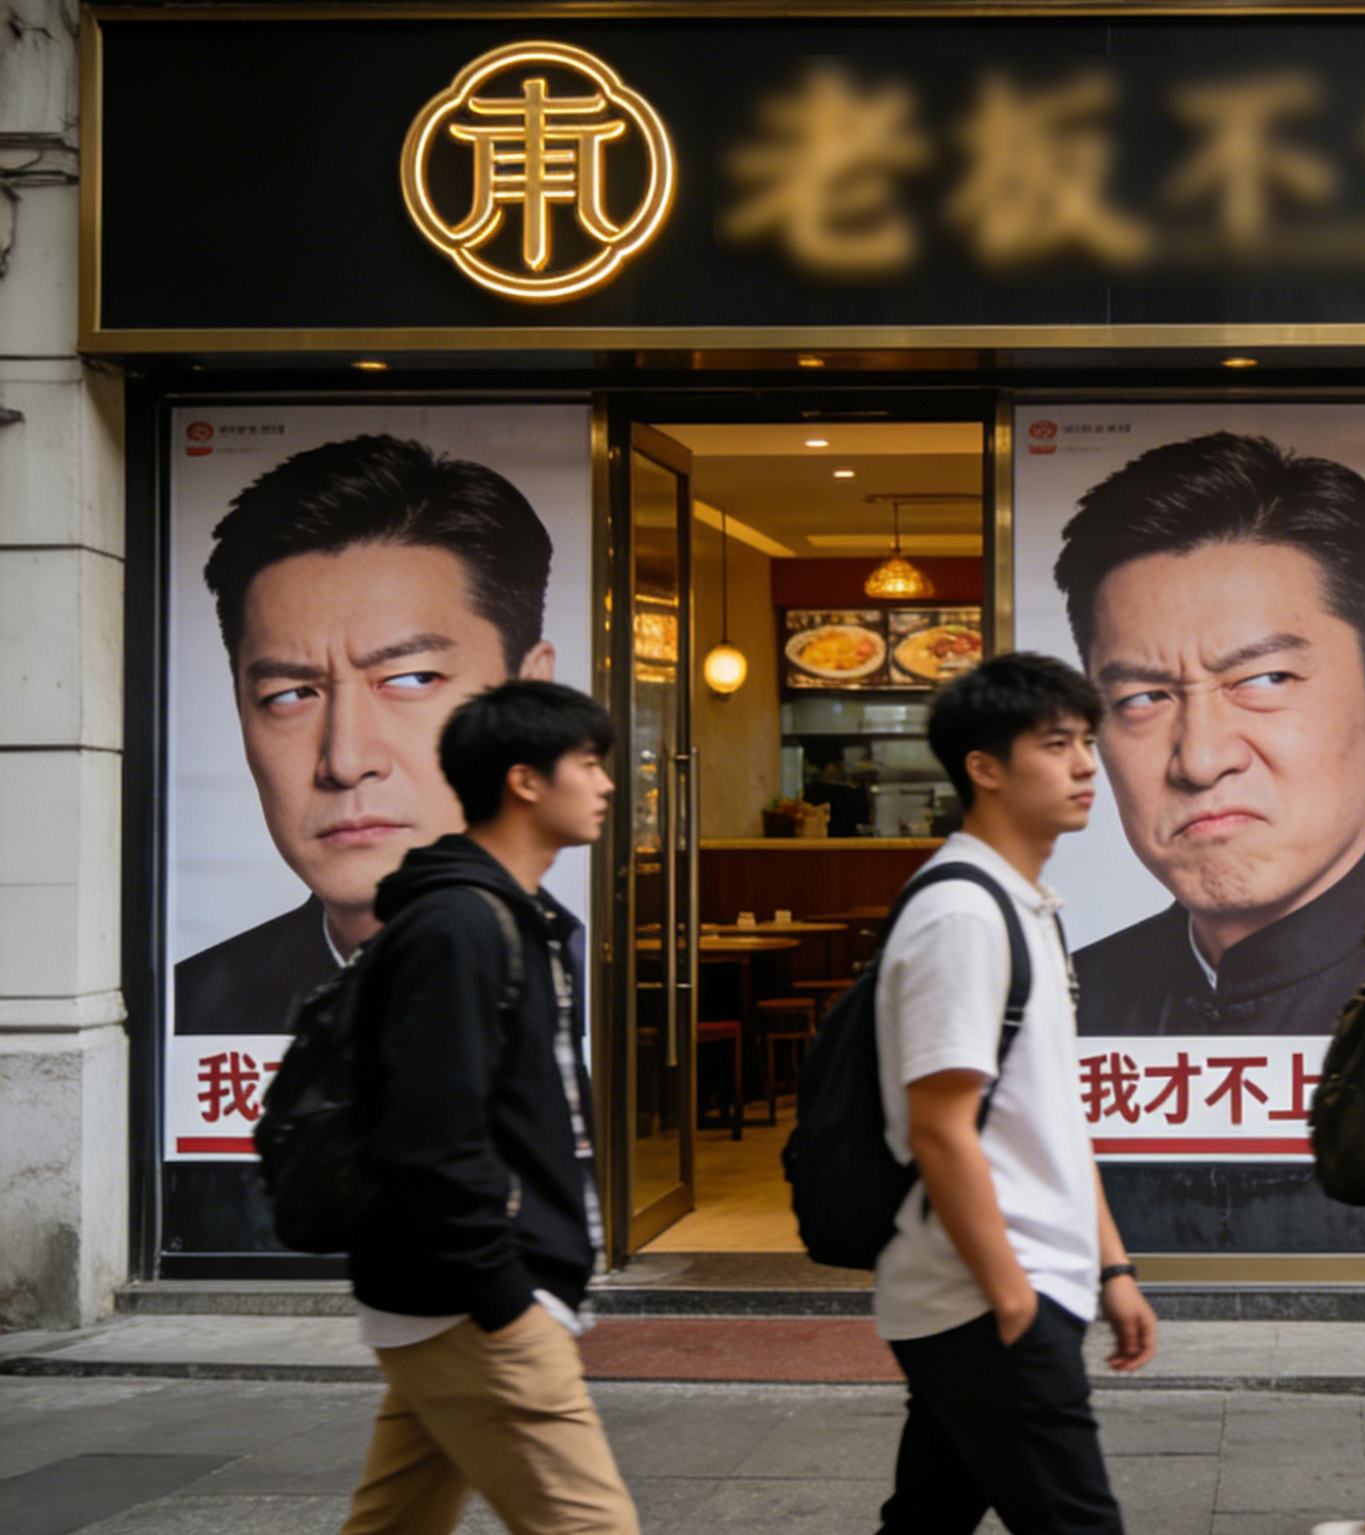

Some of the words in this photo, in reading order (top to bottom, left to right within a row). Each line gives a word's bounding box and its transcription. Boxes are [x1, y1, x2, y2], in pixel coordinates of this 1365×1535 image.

[198, 1051, 283, 1123] 我
[1079, 1052, 1322, 1125] 我才不上
